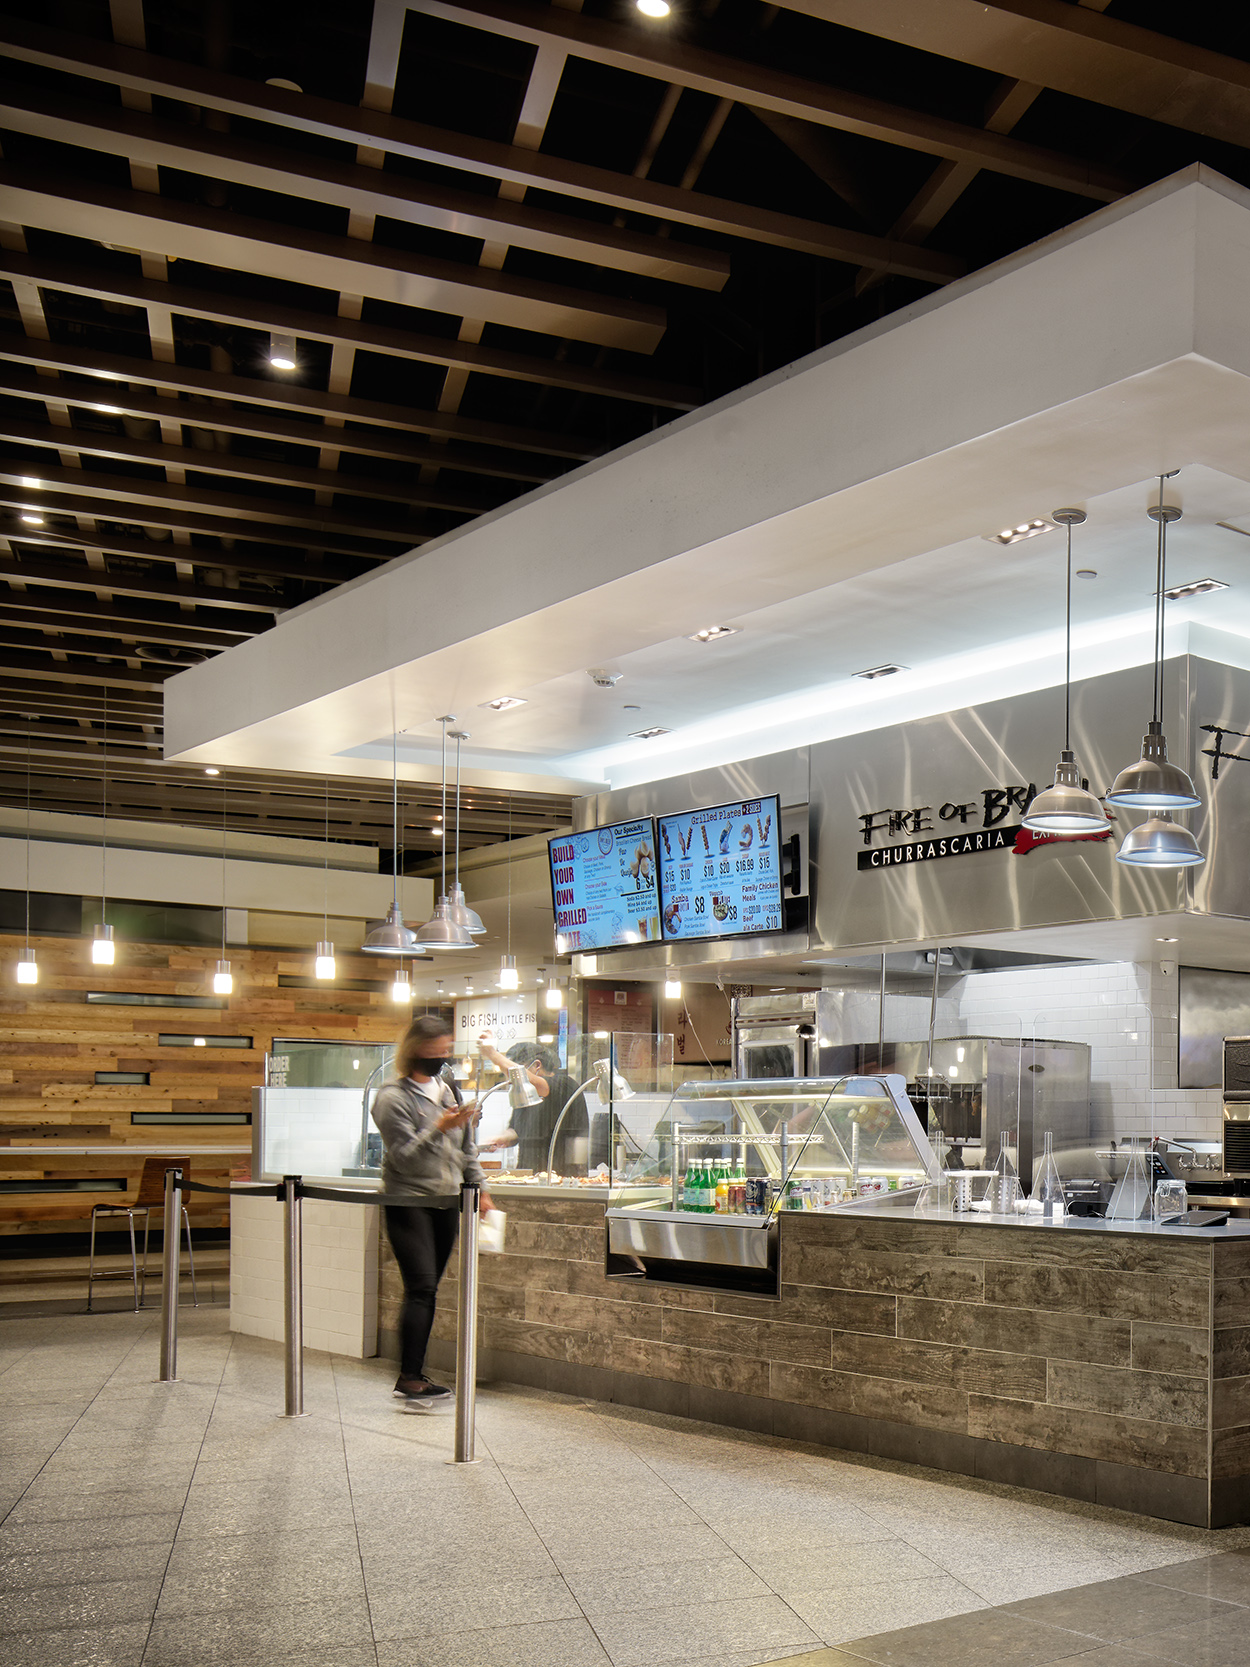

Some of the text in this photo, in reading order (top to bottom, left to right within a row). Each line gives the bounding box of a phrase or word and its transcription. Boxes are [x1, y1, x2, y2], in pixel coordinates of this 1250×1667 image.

[691, 812, 717, 824] Grilled
[719, 809, 741, 820] Plates
[858, 806, 934, 844] FIRE
[939, 802, 978, 824] OF
[552, 844, 575, 864] BUILD
[870, 831, 1004, 866] CHURRASCARIA
[720, 862, 730, 874] $20
[736, 859, 754, 872] $16.99
[759, 857, 770, 870] $15
[554, 866, 574, 884] YOUR
[665, 871, 674, 882] $15
[680, 869, 690, 880] $10
[704, 865, 714, 877] $10
[636, 877, 640, 890] 6
[742, 882, 778, 892] Family Chicken
[556, 888, 574, 906] OWN
[695, 896, 705, 914] $8
[558, 908, 587, 927] GRILLED
[729, 906, 737, 920] $8
[766, 916, 777, 929] $10
[462, 1015, 476, 1028] BIG
[478, 1013, 497, 1026] FISH
[501, 1014, 523, 1025] LITTLE
